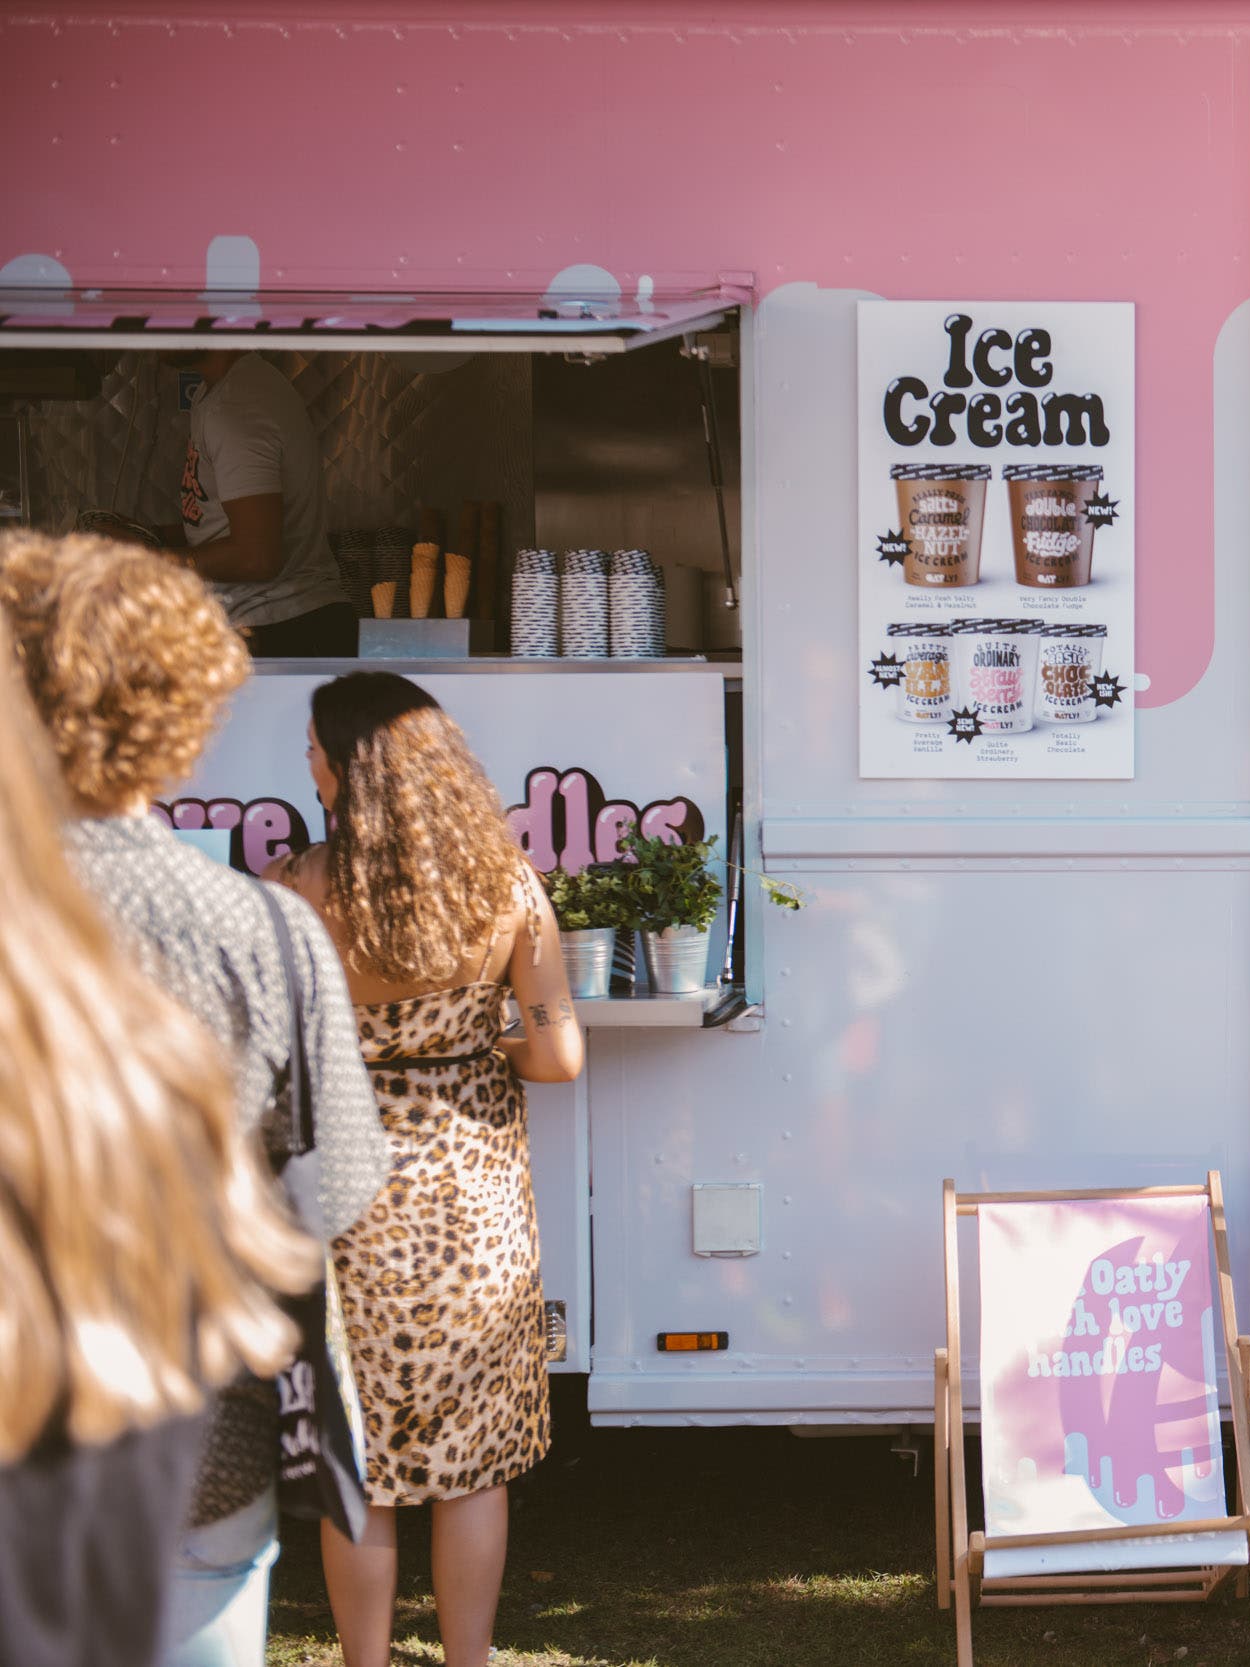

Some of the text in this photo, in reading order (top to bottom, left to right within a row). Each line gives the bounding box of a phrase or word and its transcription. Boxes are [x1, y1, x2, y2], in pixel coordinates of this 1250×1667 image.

[943, 313, 1053, 388] Ice
[883, 376, 1110, 448] Cream
[908, 507, 971, 526] Caramel
[1088, 505, 1113, 516] NEW!
[881, 542, 907, 553] NEW!
[923, 541, 961, 556] NUT
[914, 551, 969, 567] ICE CREAM
[977, 642, 1017, 653] QUITE
[1044, 644, 1089, 656] TOTALLY
[974, 651, 1021, 667] ORDINARY
[1047, 651, 1085, 665] BASIC
[1042, 664, 1091, 683] CHOC
[907, 694, 950, 706] ICE CREAM
[973, 700, 988, 712] ICE
[990, 700, 1023, 714] CREAM
[1045, 694, 1058, 705] ICE
[976, 755, 1018, 763] Strawberry
[1090, 1251, 1191, 1300] Oatly
[1108, 1297, 1183, 1336] love
[1027, 1336, 1162, 1378] handles
